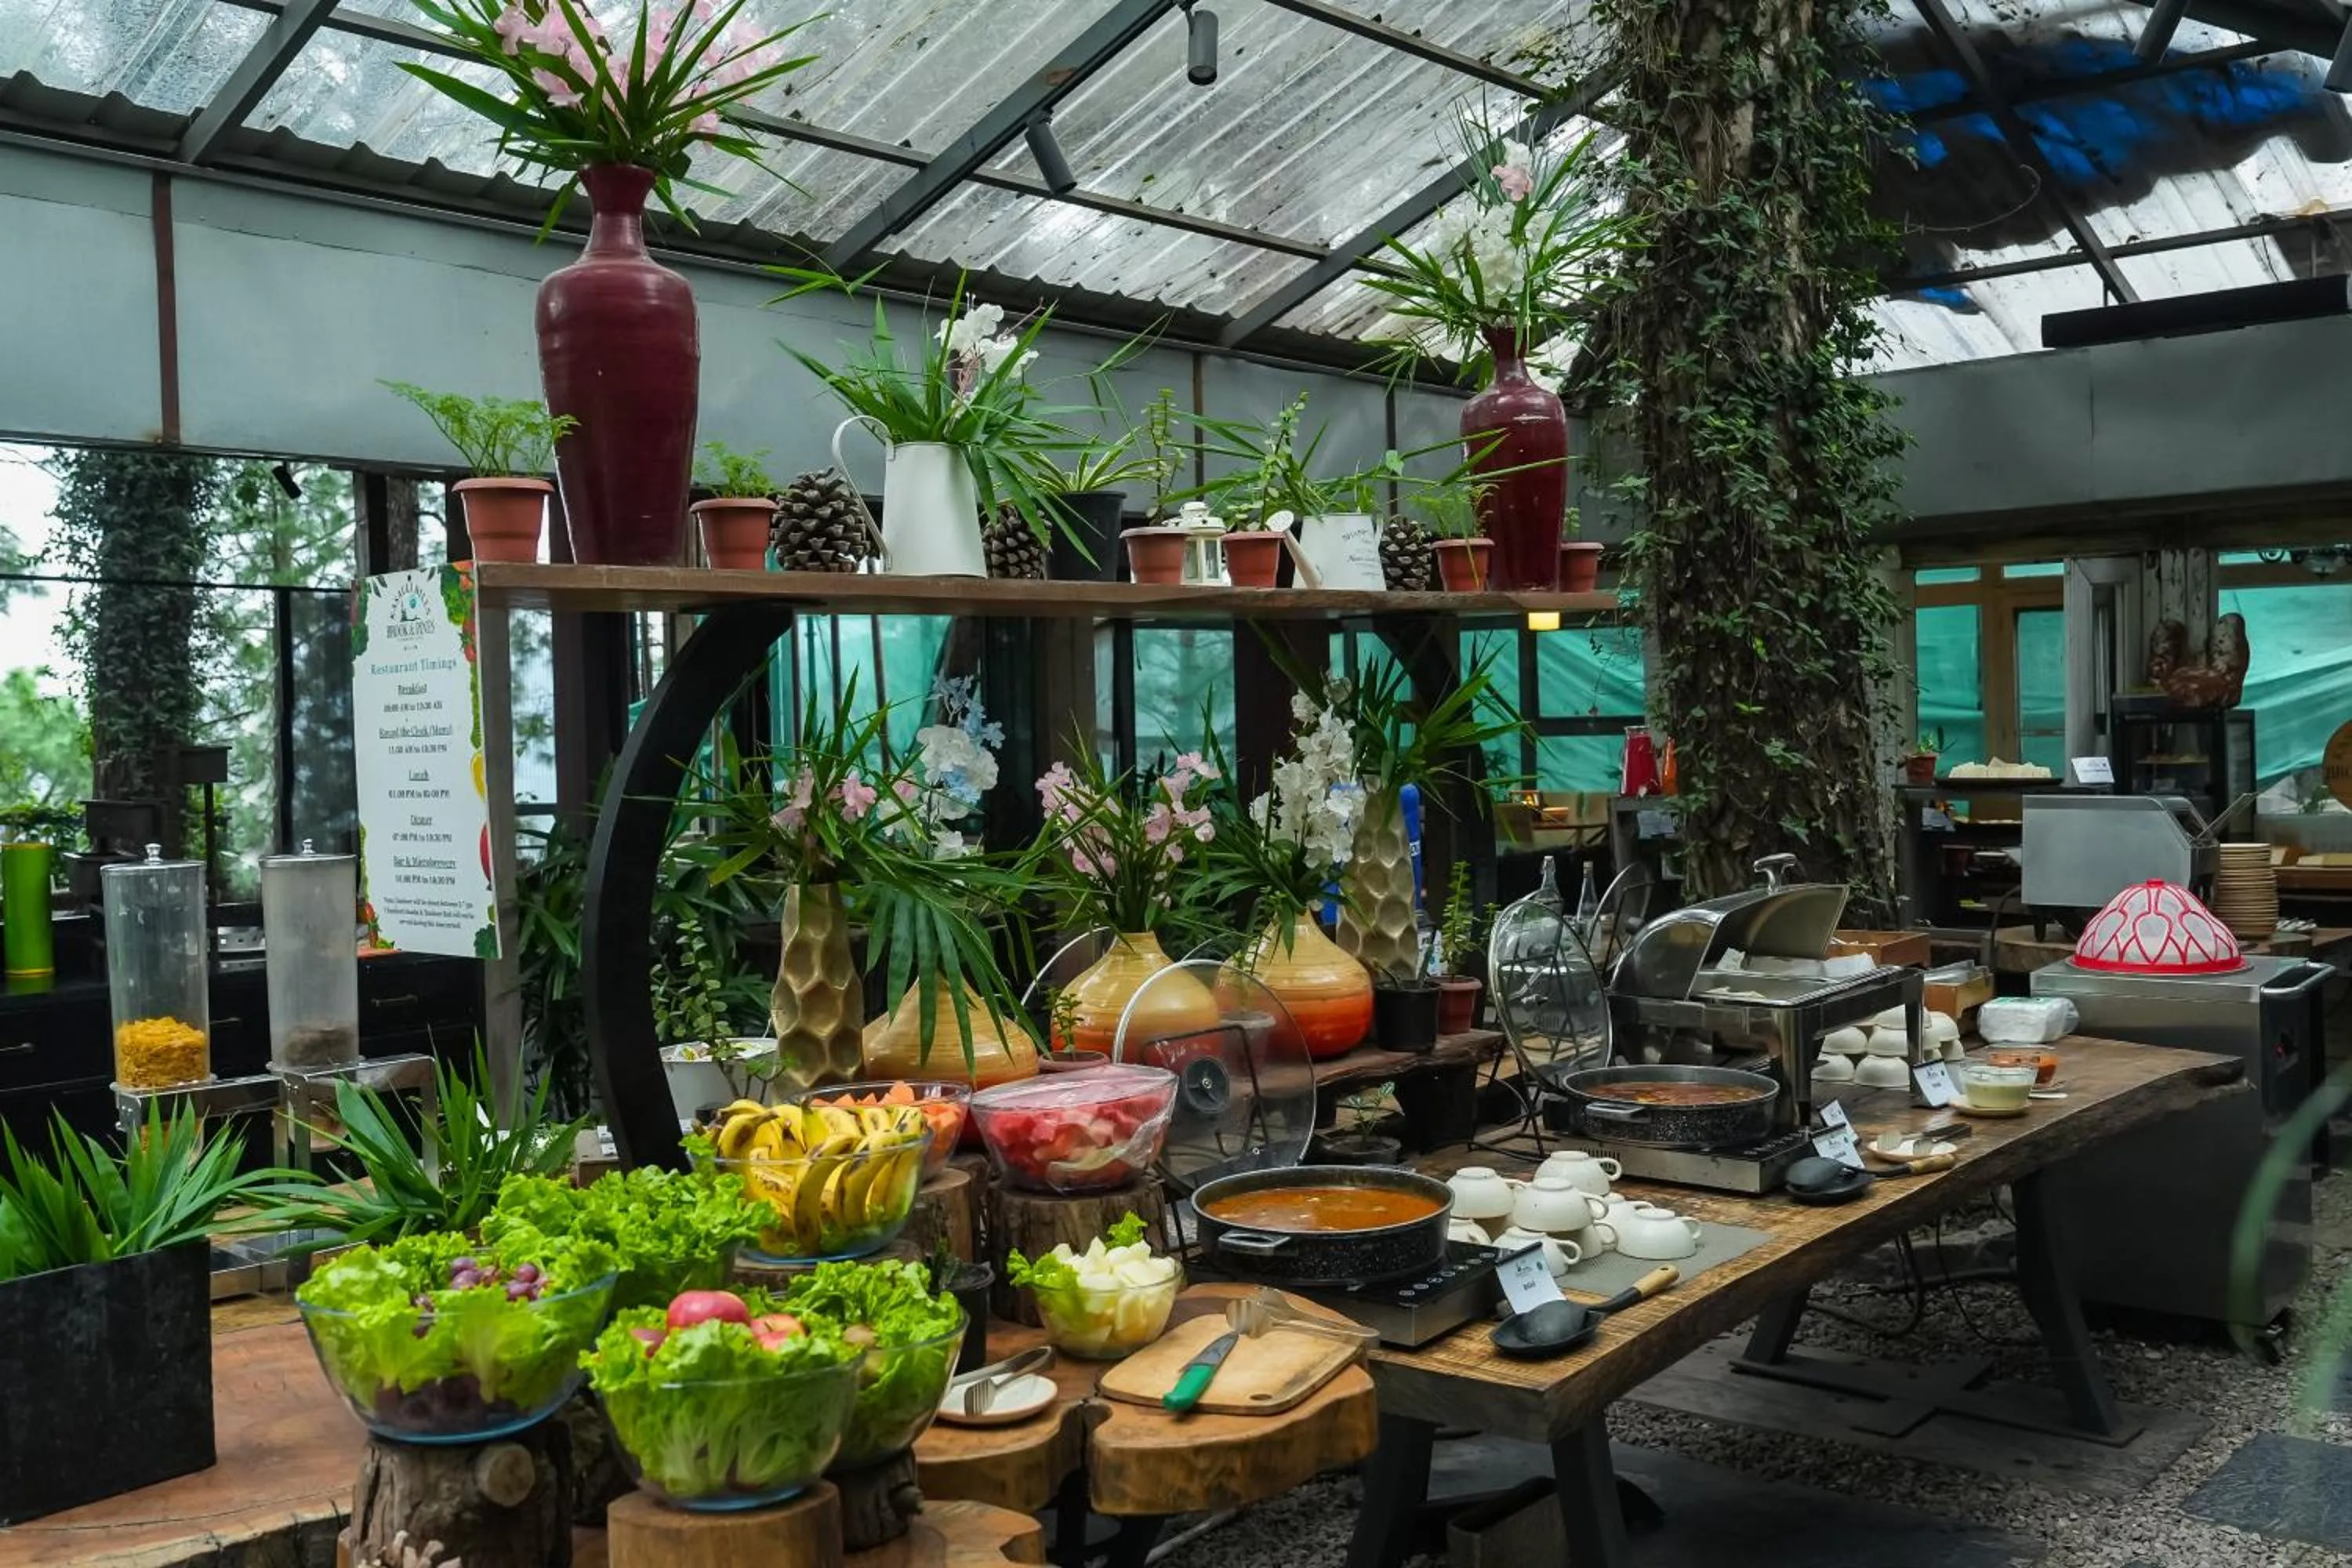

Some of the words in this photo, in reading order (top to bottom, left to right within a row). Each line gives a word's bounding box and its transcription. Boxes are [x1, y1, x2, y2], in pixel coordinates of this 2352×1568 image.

[371, 661, 418, 674] Restaurant
[419, 657, 457, 671] Timings
[408, 769, 430, 782] Lunch
[410, 815, 433, 826] Dinner
